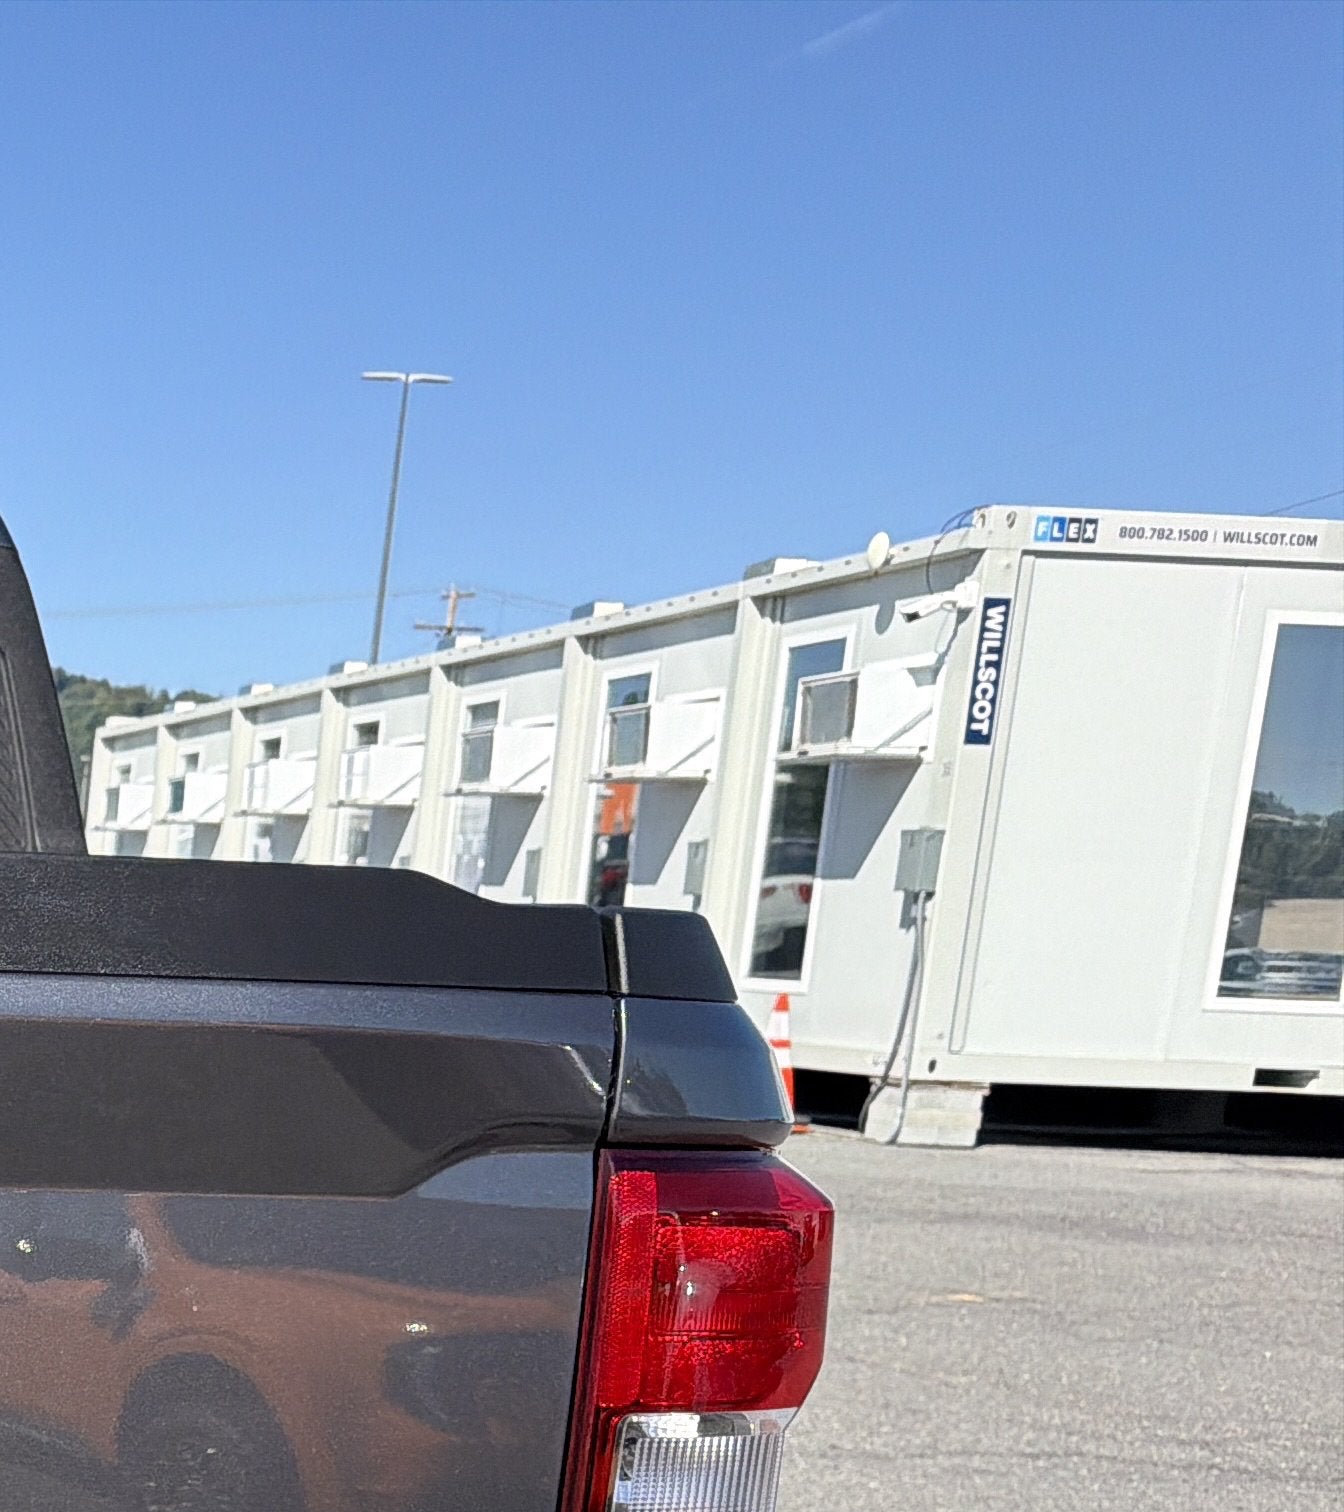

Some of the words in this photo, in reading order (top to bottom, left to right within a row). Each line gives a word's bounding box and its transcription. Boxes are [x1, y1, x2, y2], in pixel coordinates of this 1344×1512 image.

[1035, 517, 1099, 543] FLEX
[1118, 525, 1209, 543] 800.782.1500
[1222, 530, 1318, 547] WILLSCOT.COM
[969, 604, 1007, 736] WILLSCOT
